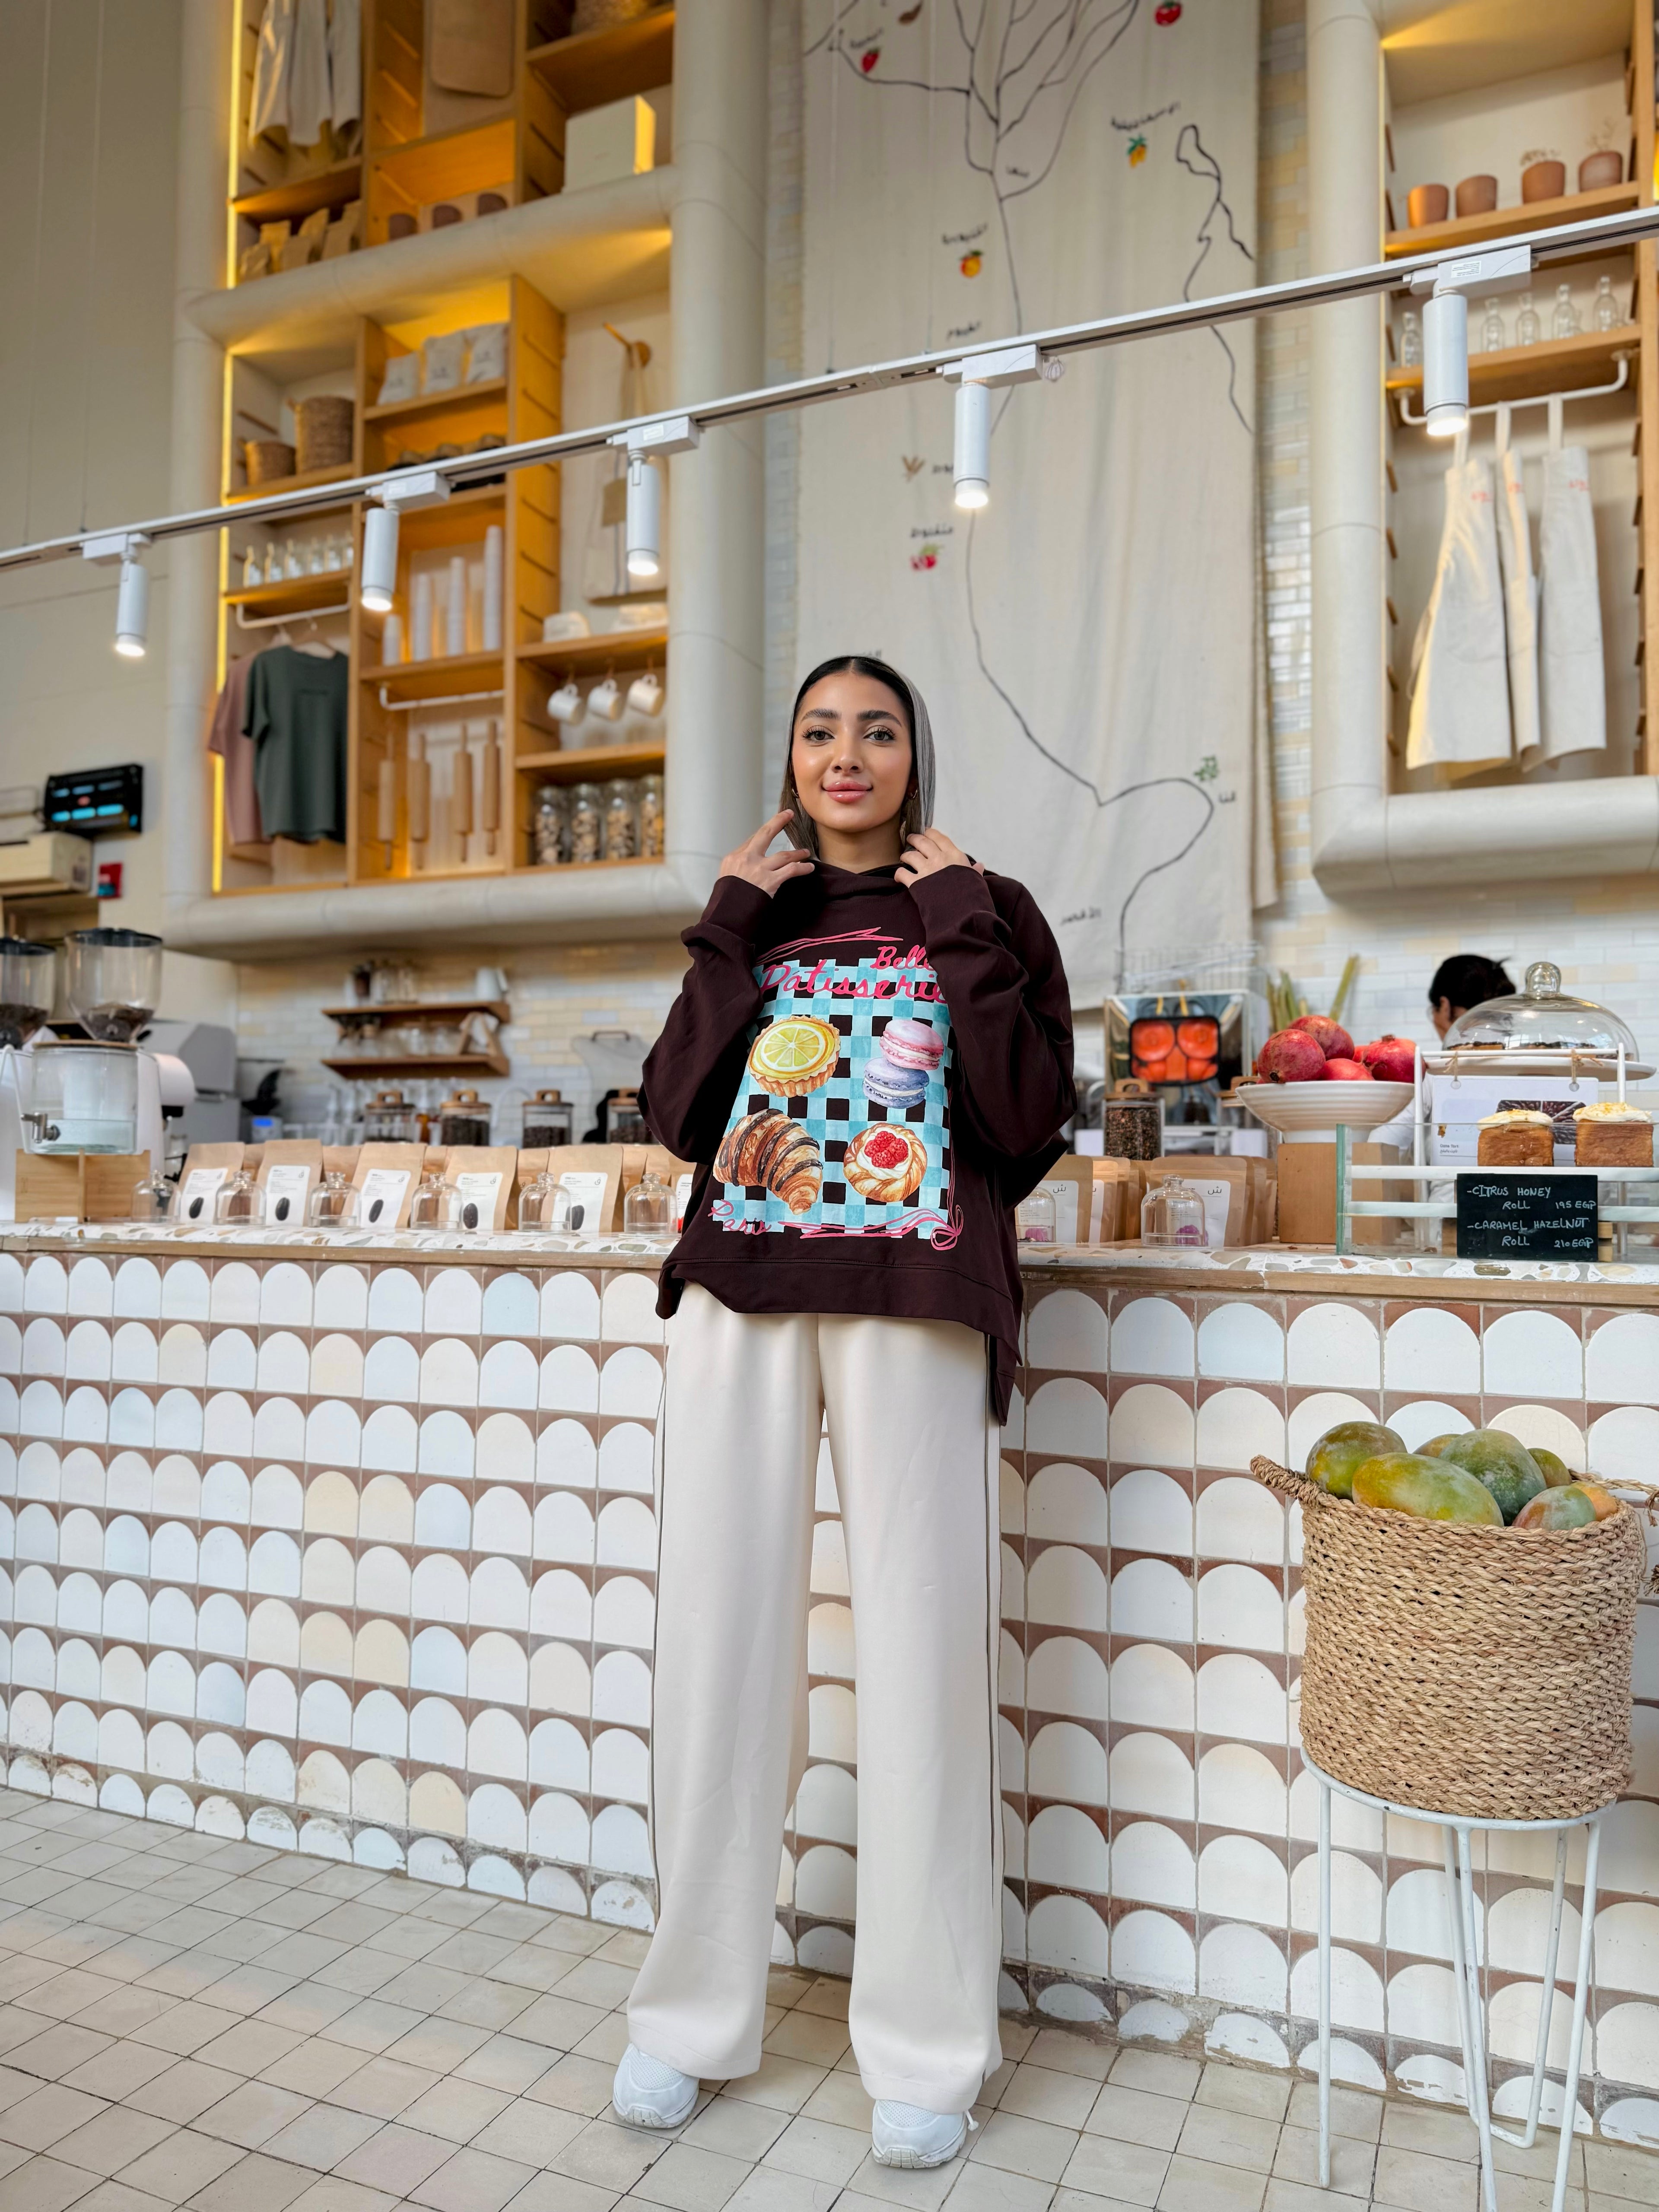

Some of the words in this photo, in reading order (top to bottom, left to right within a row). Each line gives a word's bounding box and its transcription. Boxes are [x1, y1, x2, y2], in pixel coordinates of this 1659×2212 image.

[1517, 1187, 1551, 1198] HONEY
[1555, 1201, 1572, 1209] 195
[1575, 1200, 1596, 1210] EGP
[708, 1199, 772, 1235] Paris
[1534, 1217, 1589, 1228] HAZELNUT
[1554, 1239, 1570, 1248] 210
[1572, 1237, 1594, 1249] EGP
